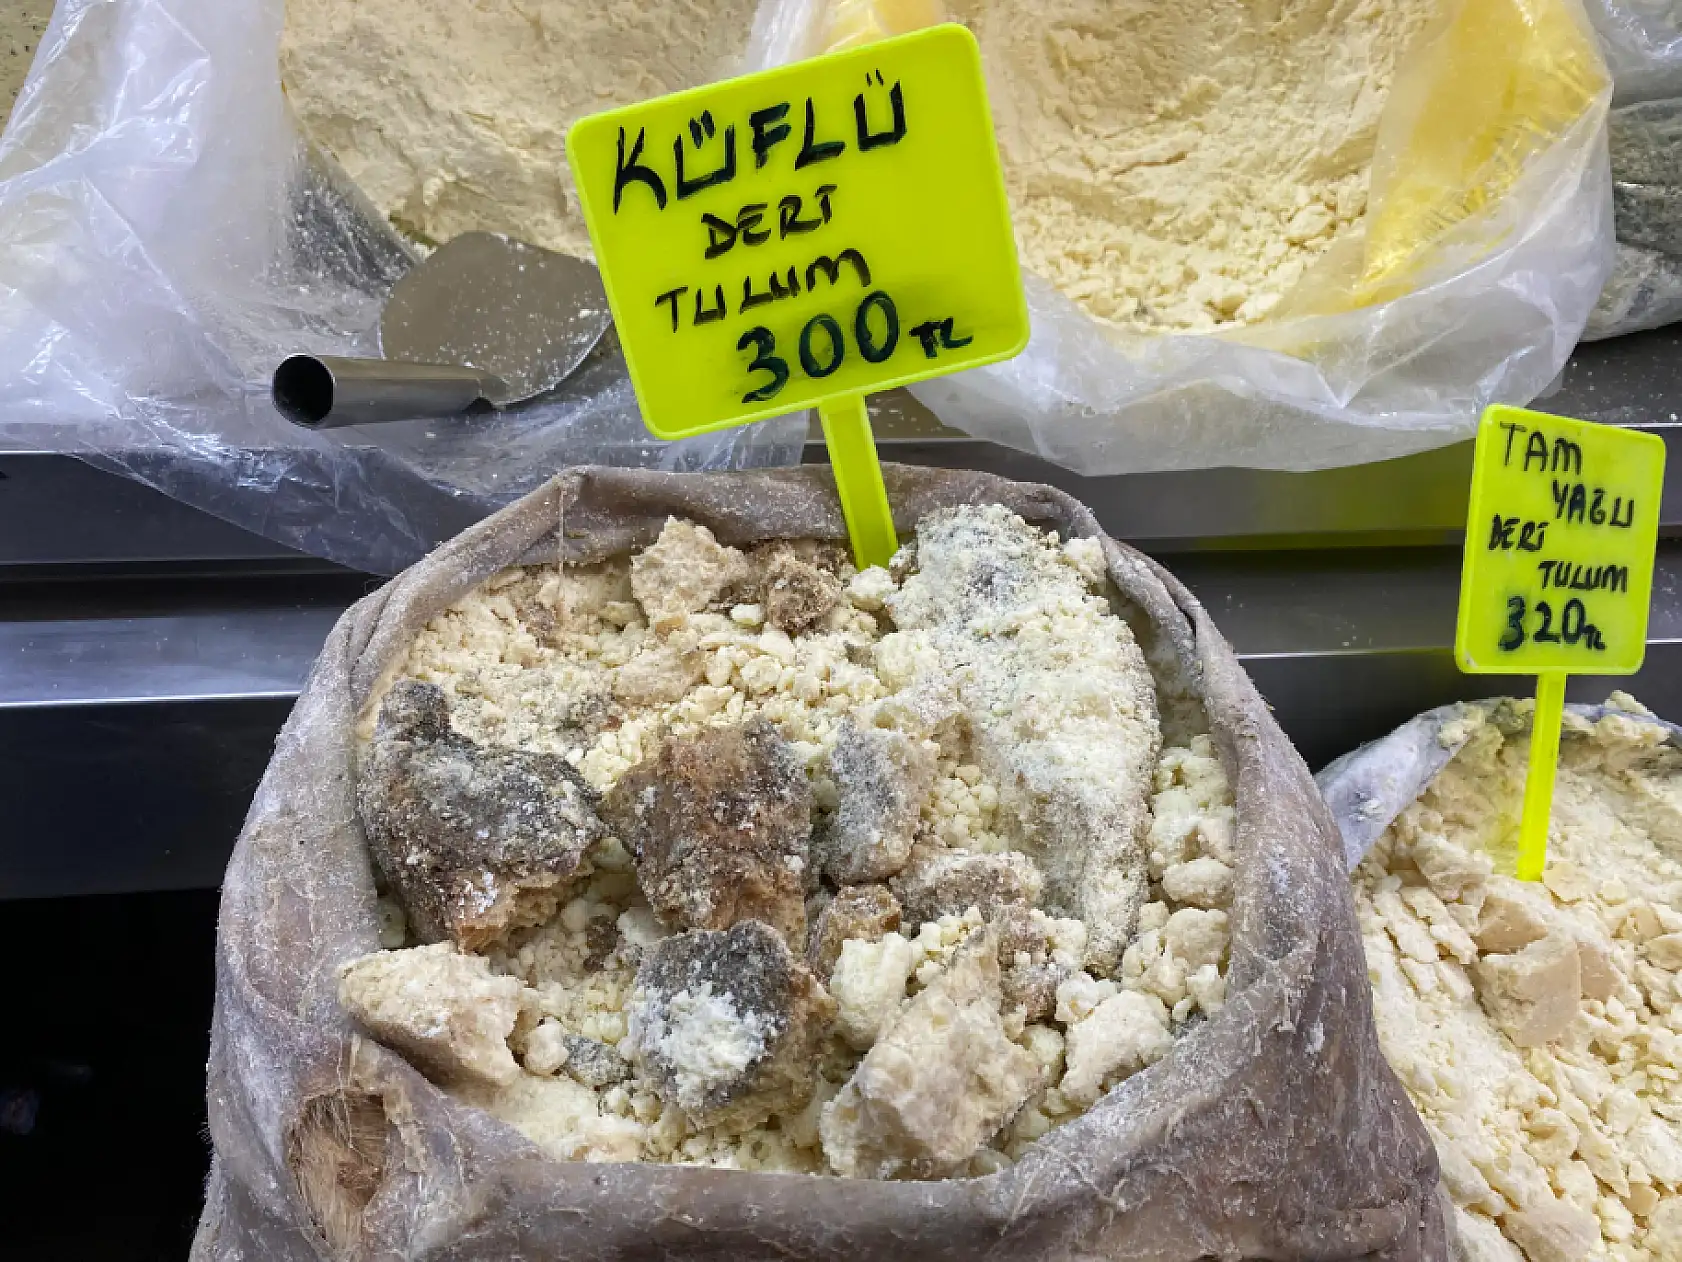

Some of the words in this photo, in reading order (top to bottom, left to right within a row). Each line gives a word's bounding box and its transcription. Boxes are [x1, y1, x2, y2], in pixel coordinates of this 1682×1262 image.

[613, 69, 907, 215] KÜFLÜ
[654, 248, 872, 333] TULUM
[1500, 421, 1582, 475] TAM
[1538, 560, 1628, 592] TULUM
